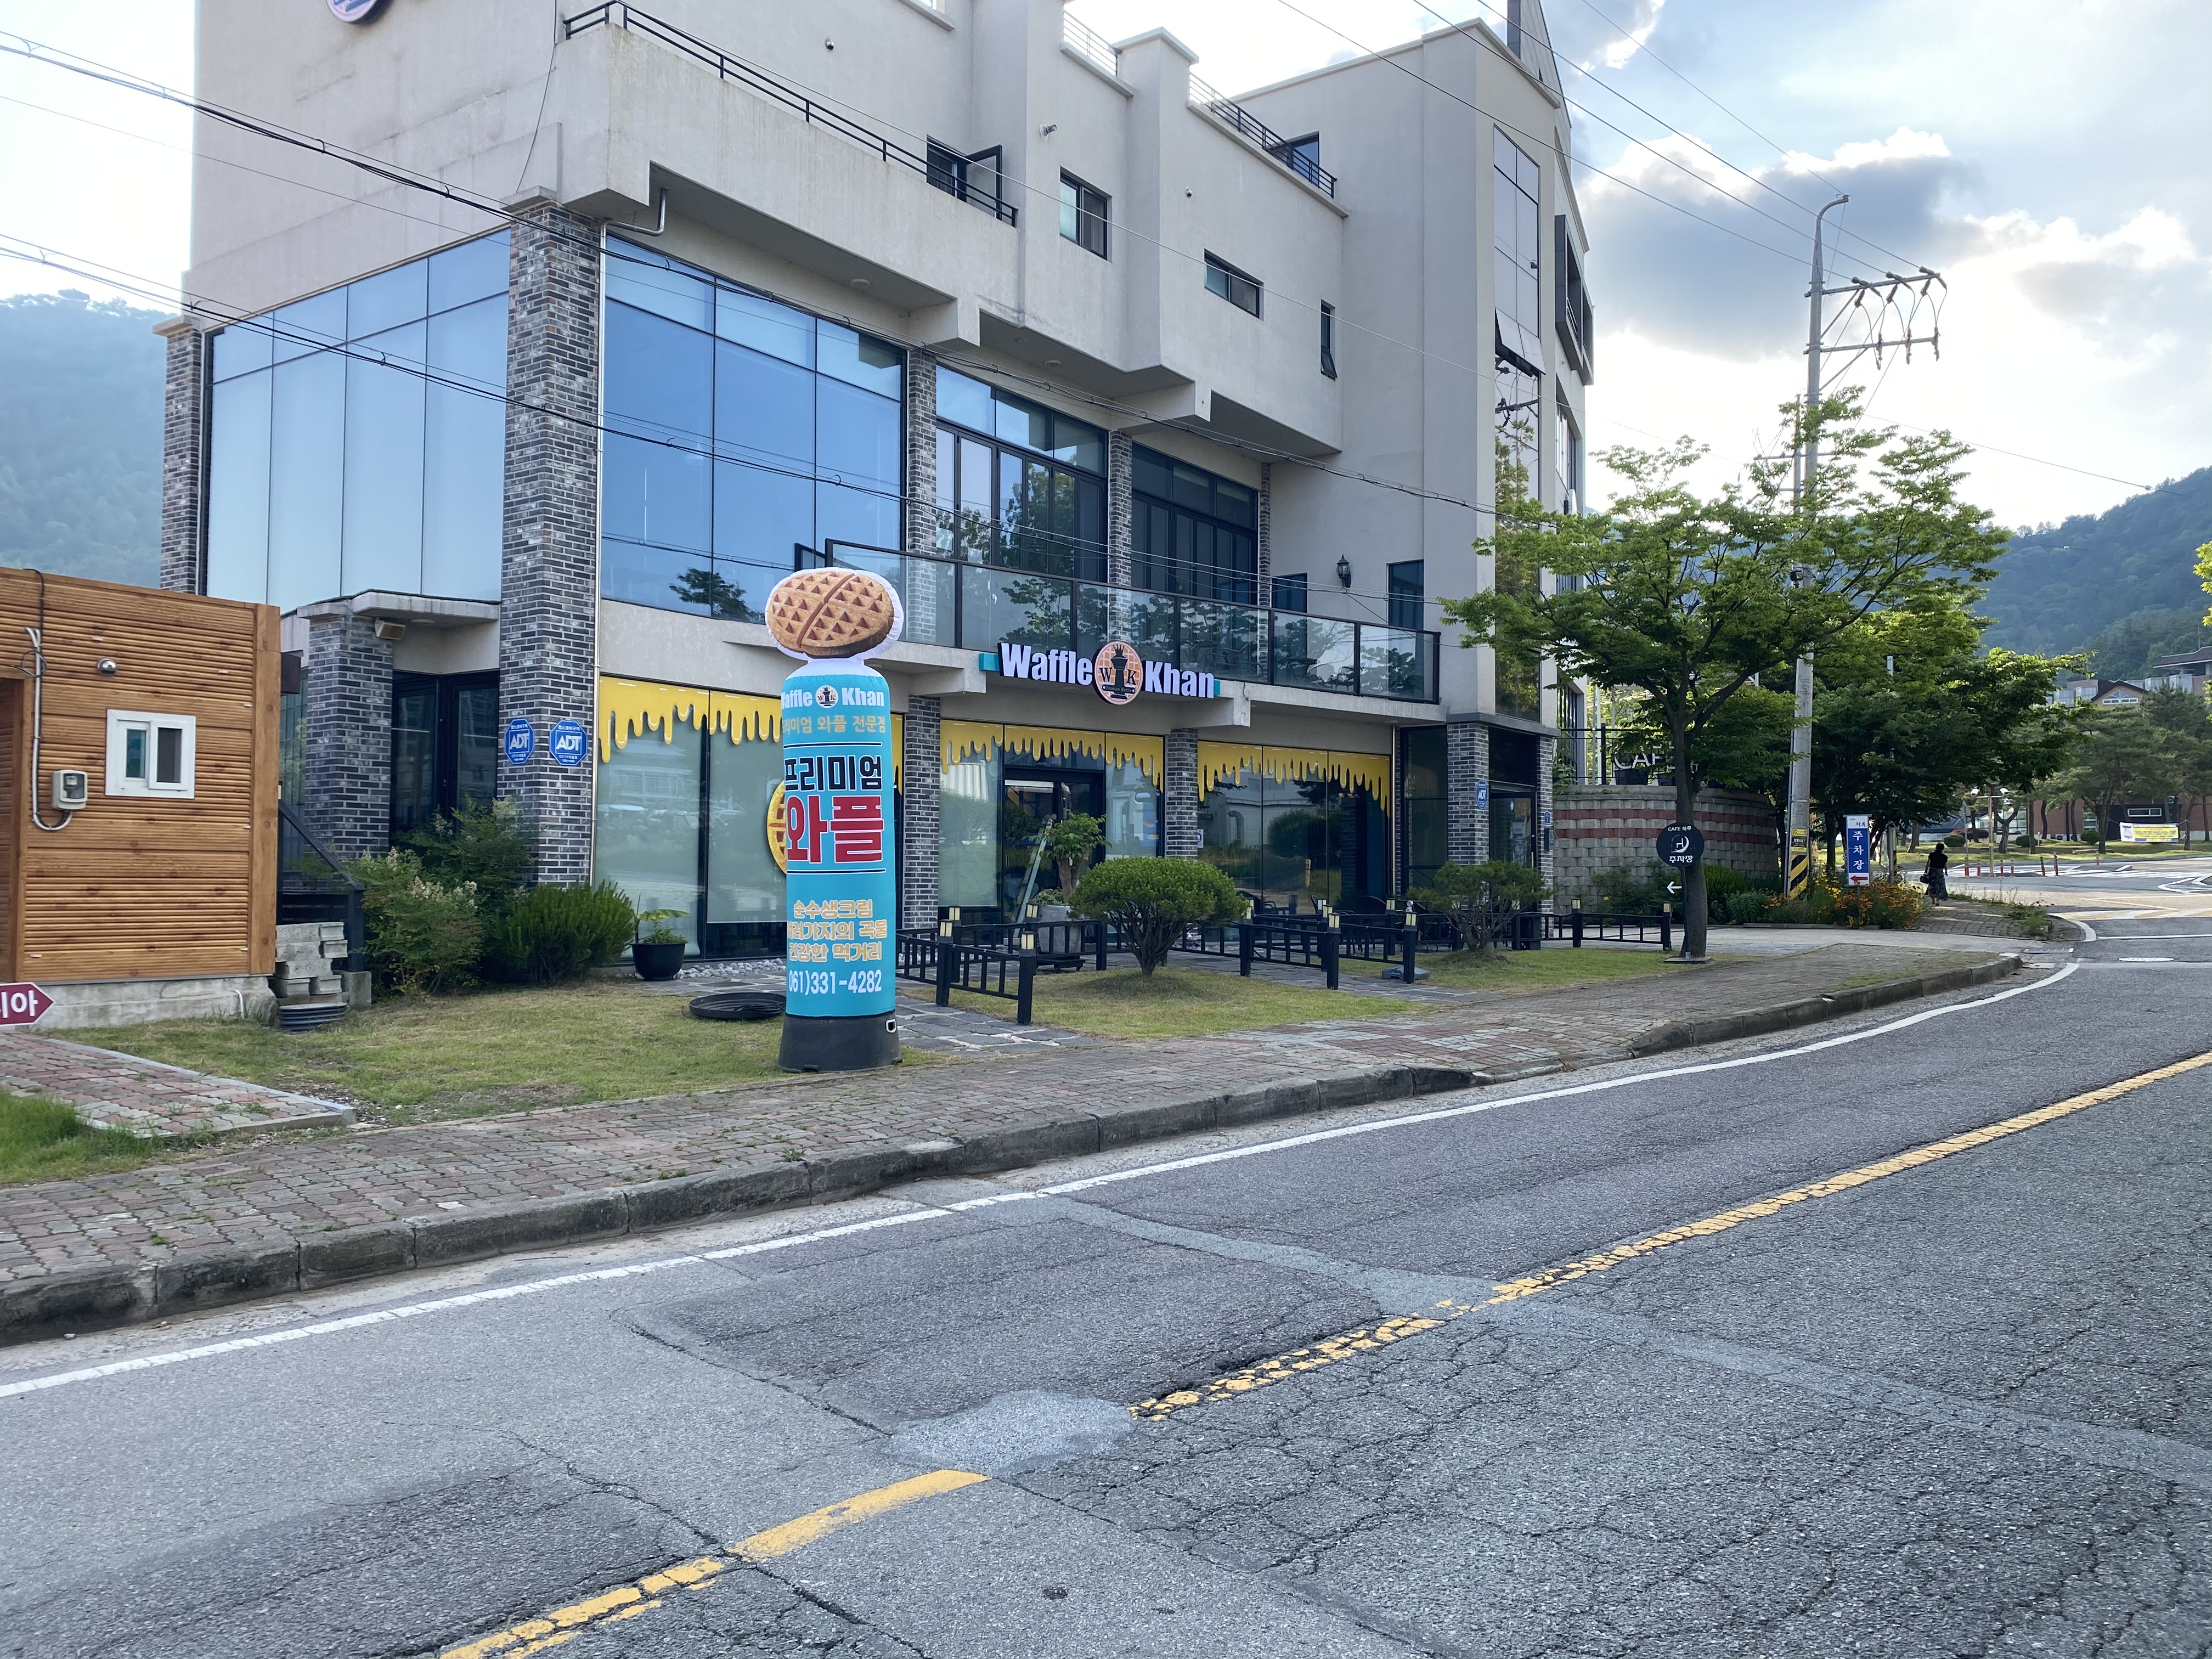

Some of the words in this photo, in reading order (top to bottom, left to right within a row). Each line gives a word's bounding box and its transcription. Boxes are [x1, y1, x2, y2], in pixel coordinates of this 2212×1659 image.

[998, 642, 1093, 686] Waffle
[1144, 660, 1215, 699] Khan
[1099, 667, 1113, 682] W
[1126, 669, 1138, 685] K
[841, 687, 884, 707] Khan
[817, 715, 847, 733] 와플
[852, 715, 886, 733] 전문점
[509, 733, 529, 749] ADT
[556, 735, 582, 751] ADT
[785, 755, 883, 792] 프리미엄
[1478, 790, 1487, 800] ADT
[787, 794, 884, 864] 와플
[1852, 831, 1864, 870] 주차장
[793, 899, 873, 919] 순수생크림
[859, 919, 887, 940] 곡물
[789, 942, 828, 962] 건강한
[832, 940, 882, 962] 먹거리
[789, 969, 882, 996] 061)331-4282
